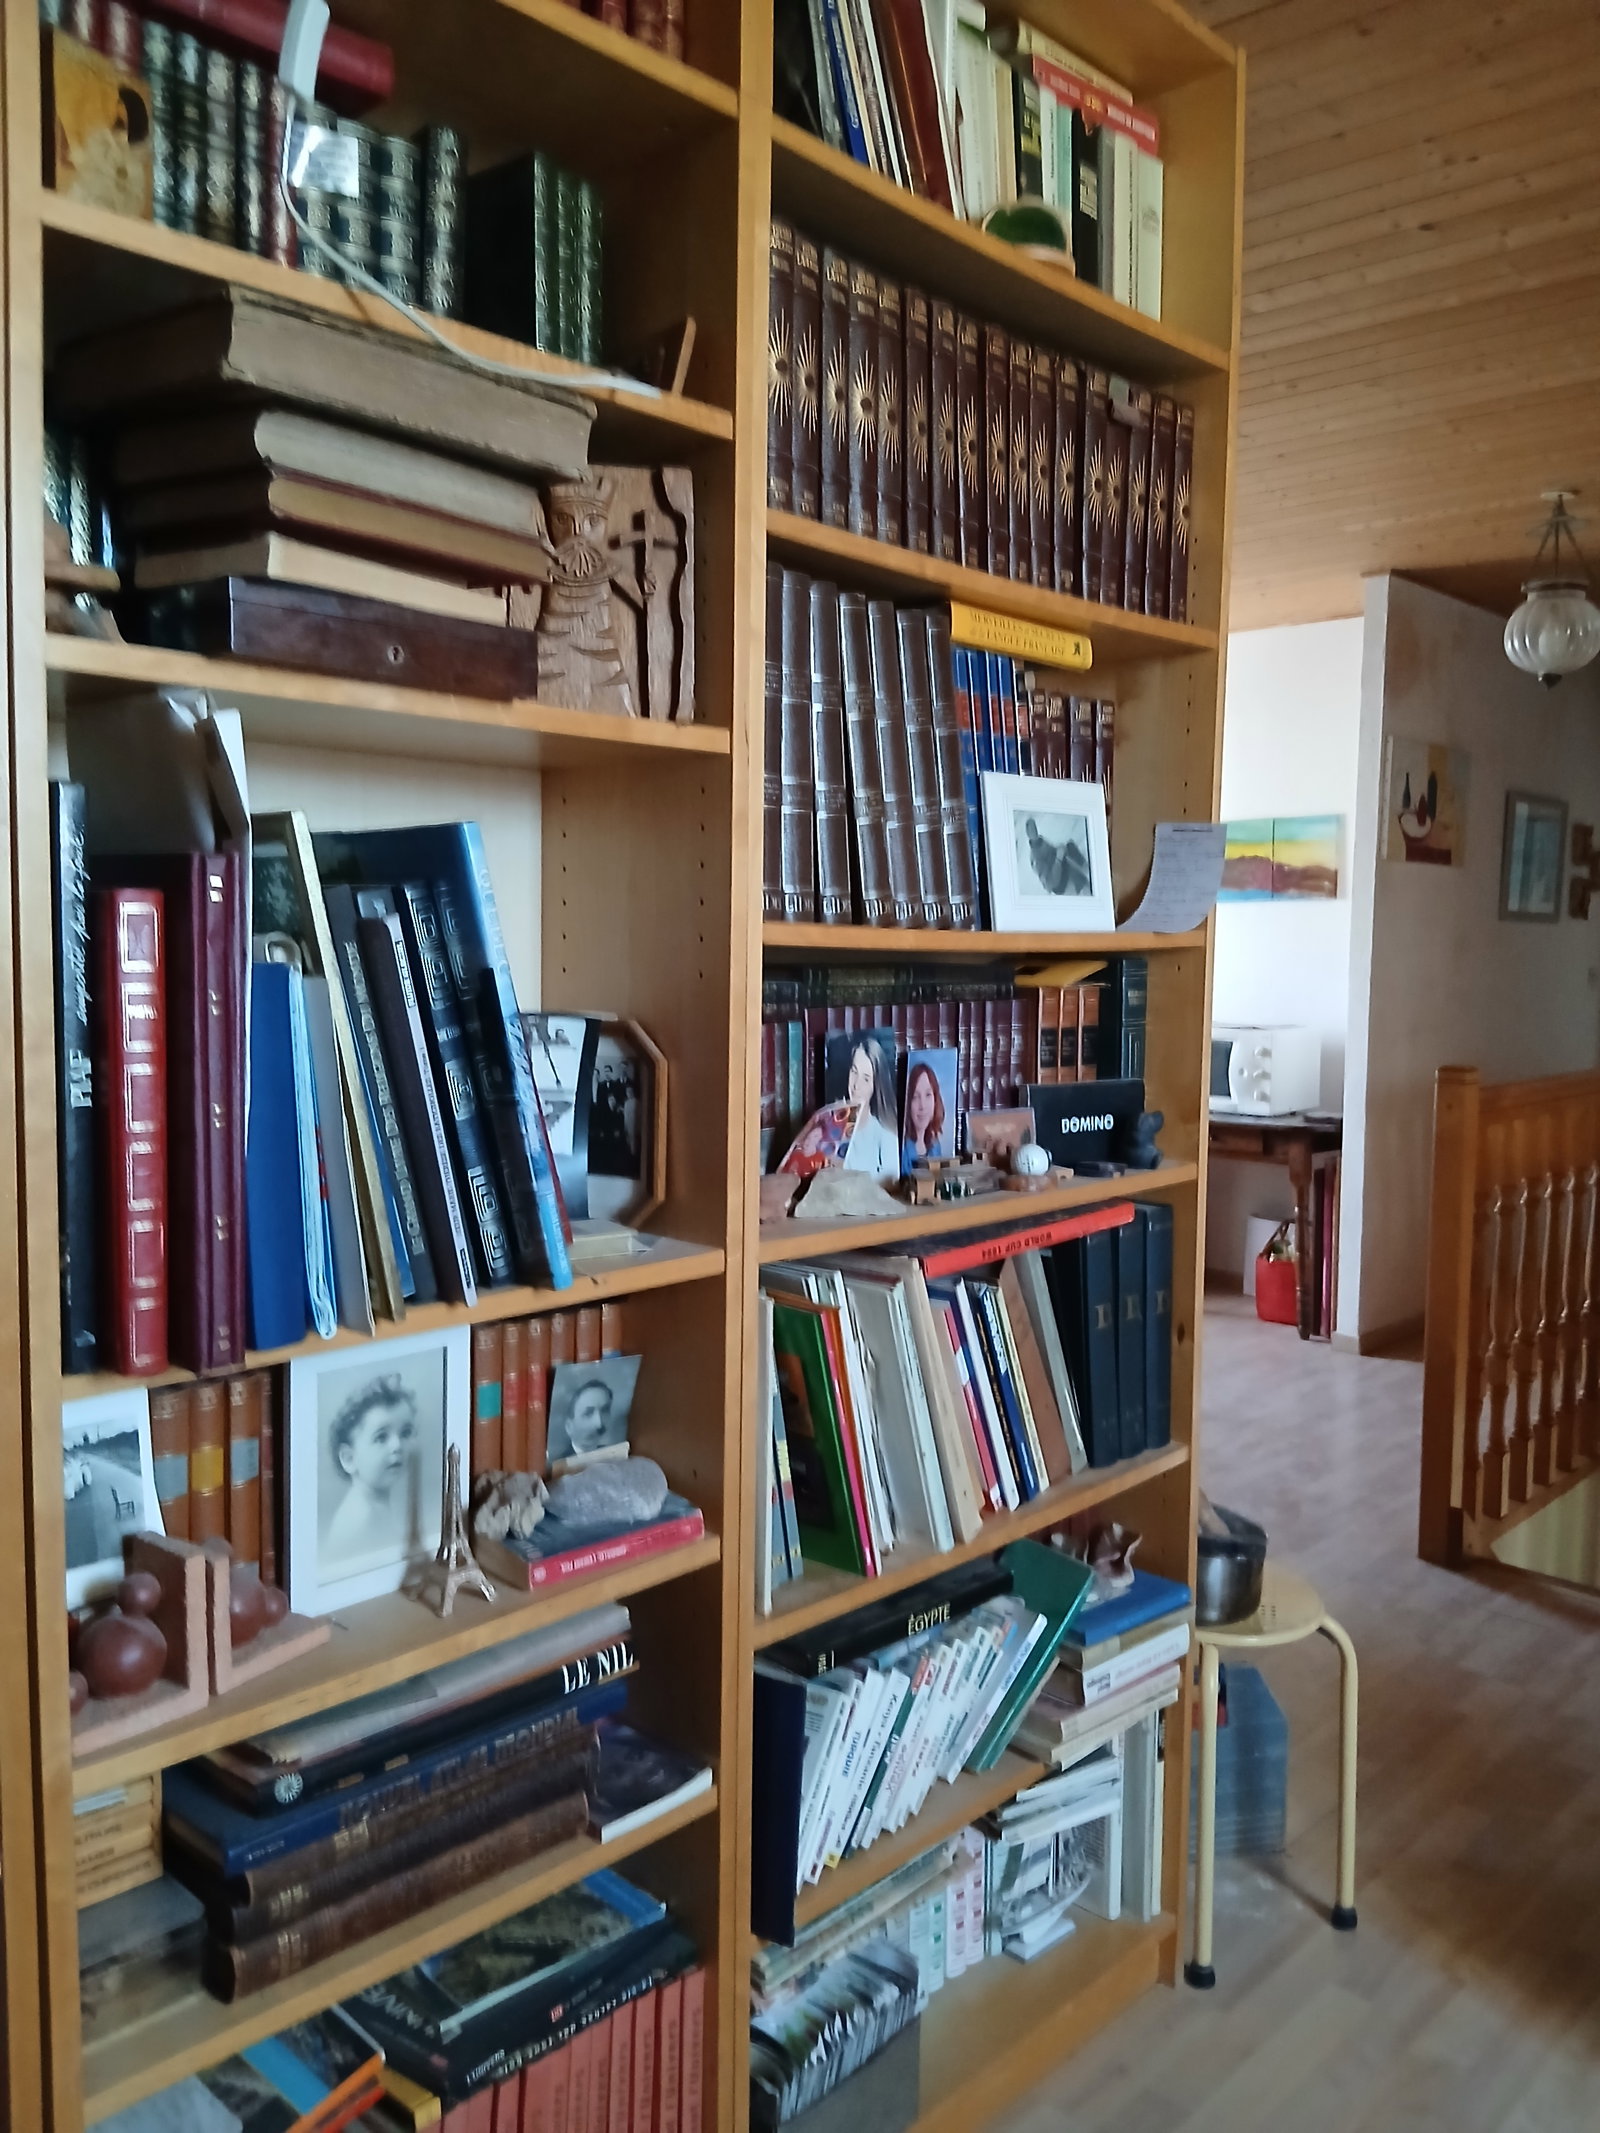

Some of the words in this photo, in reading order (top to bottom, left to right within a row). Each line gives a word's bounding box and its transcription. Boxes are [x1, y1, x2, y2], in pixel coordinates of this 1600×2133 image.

[1061, 1114, 1114, 1134] DOMINO
[1004, 1241, 1022, 1253] CUP
[1024, 1232, 1053, 1247] WORLD
[908, 1601, 951, 1637] ÉGYPTE
[561, 1664, 591, 1694] LE
[597, 1641, 634, 1680] NIL
[842, 1731, 861, 1777] TURQUIE
